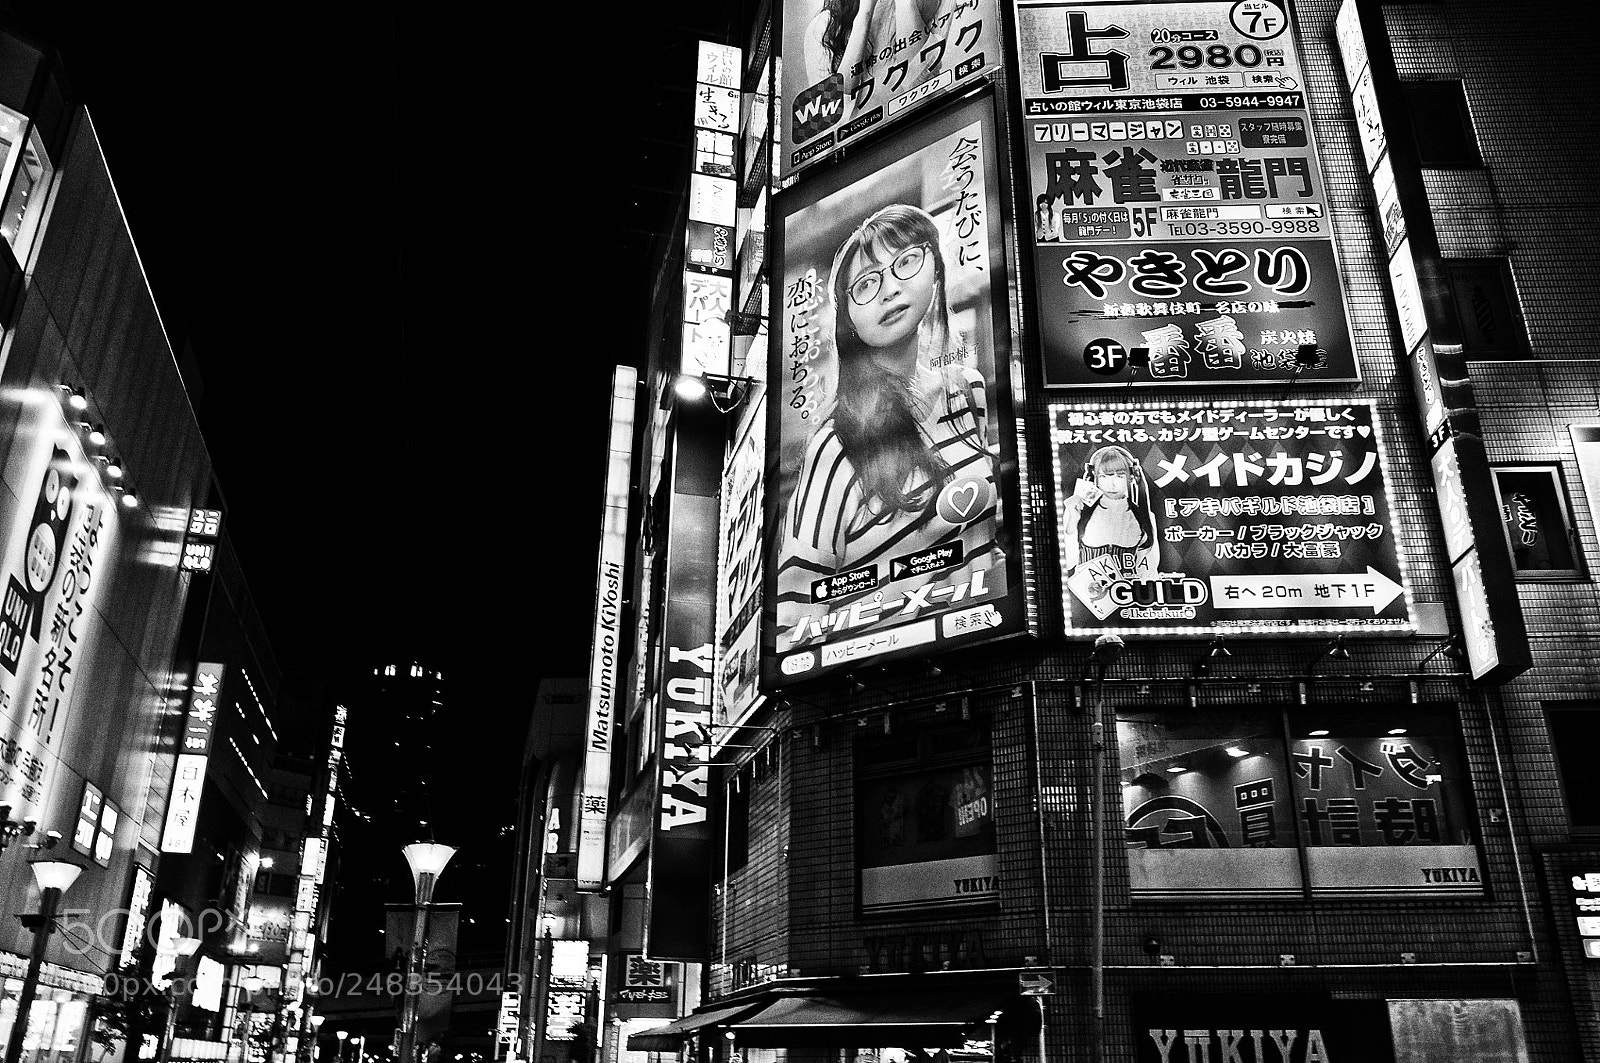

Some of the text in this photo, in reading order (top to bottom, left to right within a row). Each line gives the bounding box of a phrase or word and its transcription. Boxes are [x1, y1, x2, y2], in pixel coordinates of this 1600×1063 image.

[1241, 12, 1278, 33] 7F
[1151, 29, 1218, 43] 20分コース
[1041, 11, 1130, 94] 占
[1150, 44, 1263, 70] 2980
[1266, 57, 1285, 67] 円
[851, 20, 983, 110] ワクワク
[957, 58, 981, 77] 検索
[1251, 74, 1274, 84] 検索
[899, 79, 941, 106] ワクワク
[1200, 95, 1301, 109] 03-5944-9947
[1029, 98, 1183, 113] 占いの館ウィル東京池袋店
[1035, 122, 1182, 141] フリーマージャン
[1045, 147, 1162, 205] 麻雀
[1215, 157, 1314, 200] 龍門
[949, 137, 984, 271] 会うたびに、
[1166, 208, 1219, 219] 麻雀龍門
[1282, 207, 1306, 215] 検索
[1132, 207, 1158, 237] 5F
[1063, 246, 1312, 299] やきとり
[1102, 302, 1201, 317] 新宿歌舞伎町
[787, 274, 812, 421] 恋におちる。
[1089, 346, 1125, 369] 3F
[1067, 408, 1356, 426] 初心者の方でもメイドディーラーが優しく
[1154, 450, 1378, 488] メイドカジノ
[910, 547, 953, 567] Google Play
[830, 578, 876, 597] からダウンロード
[831, 568, 871, 587] App Store
[1110, 580, 1206, 606] GUILD
[1224, 583, 1376, 600] 右へ20m 地下1F
[5, 586, 28, 631] UNI
[789, 569, 990, 644] ハッピーメール
[954, 612, 982, 631] 検索
[826, 634, 900, 660] ハッピーメール
[592, 634, 615, 751] Matsumoto
